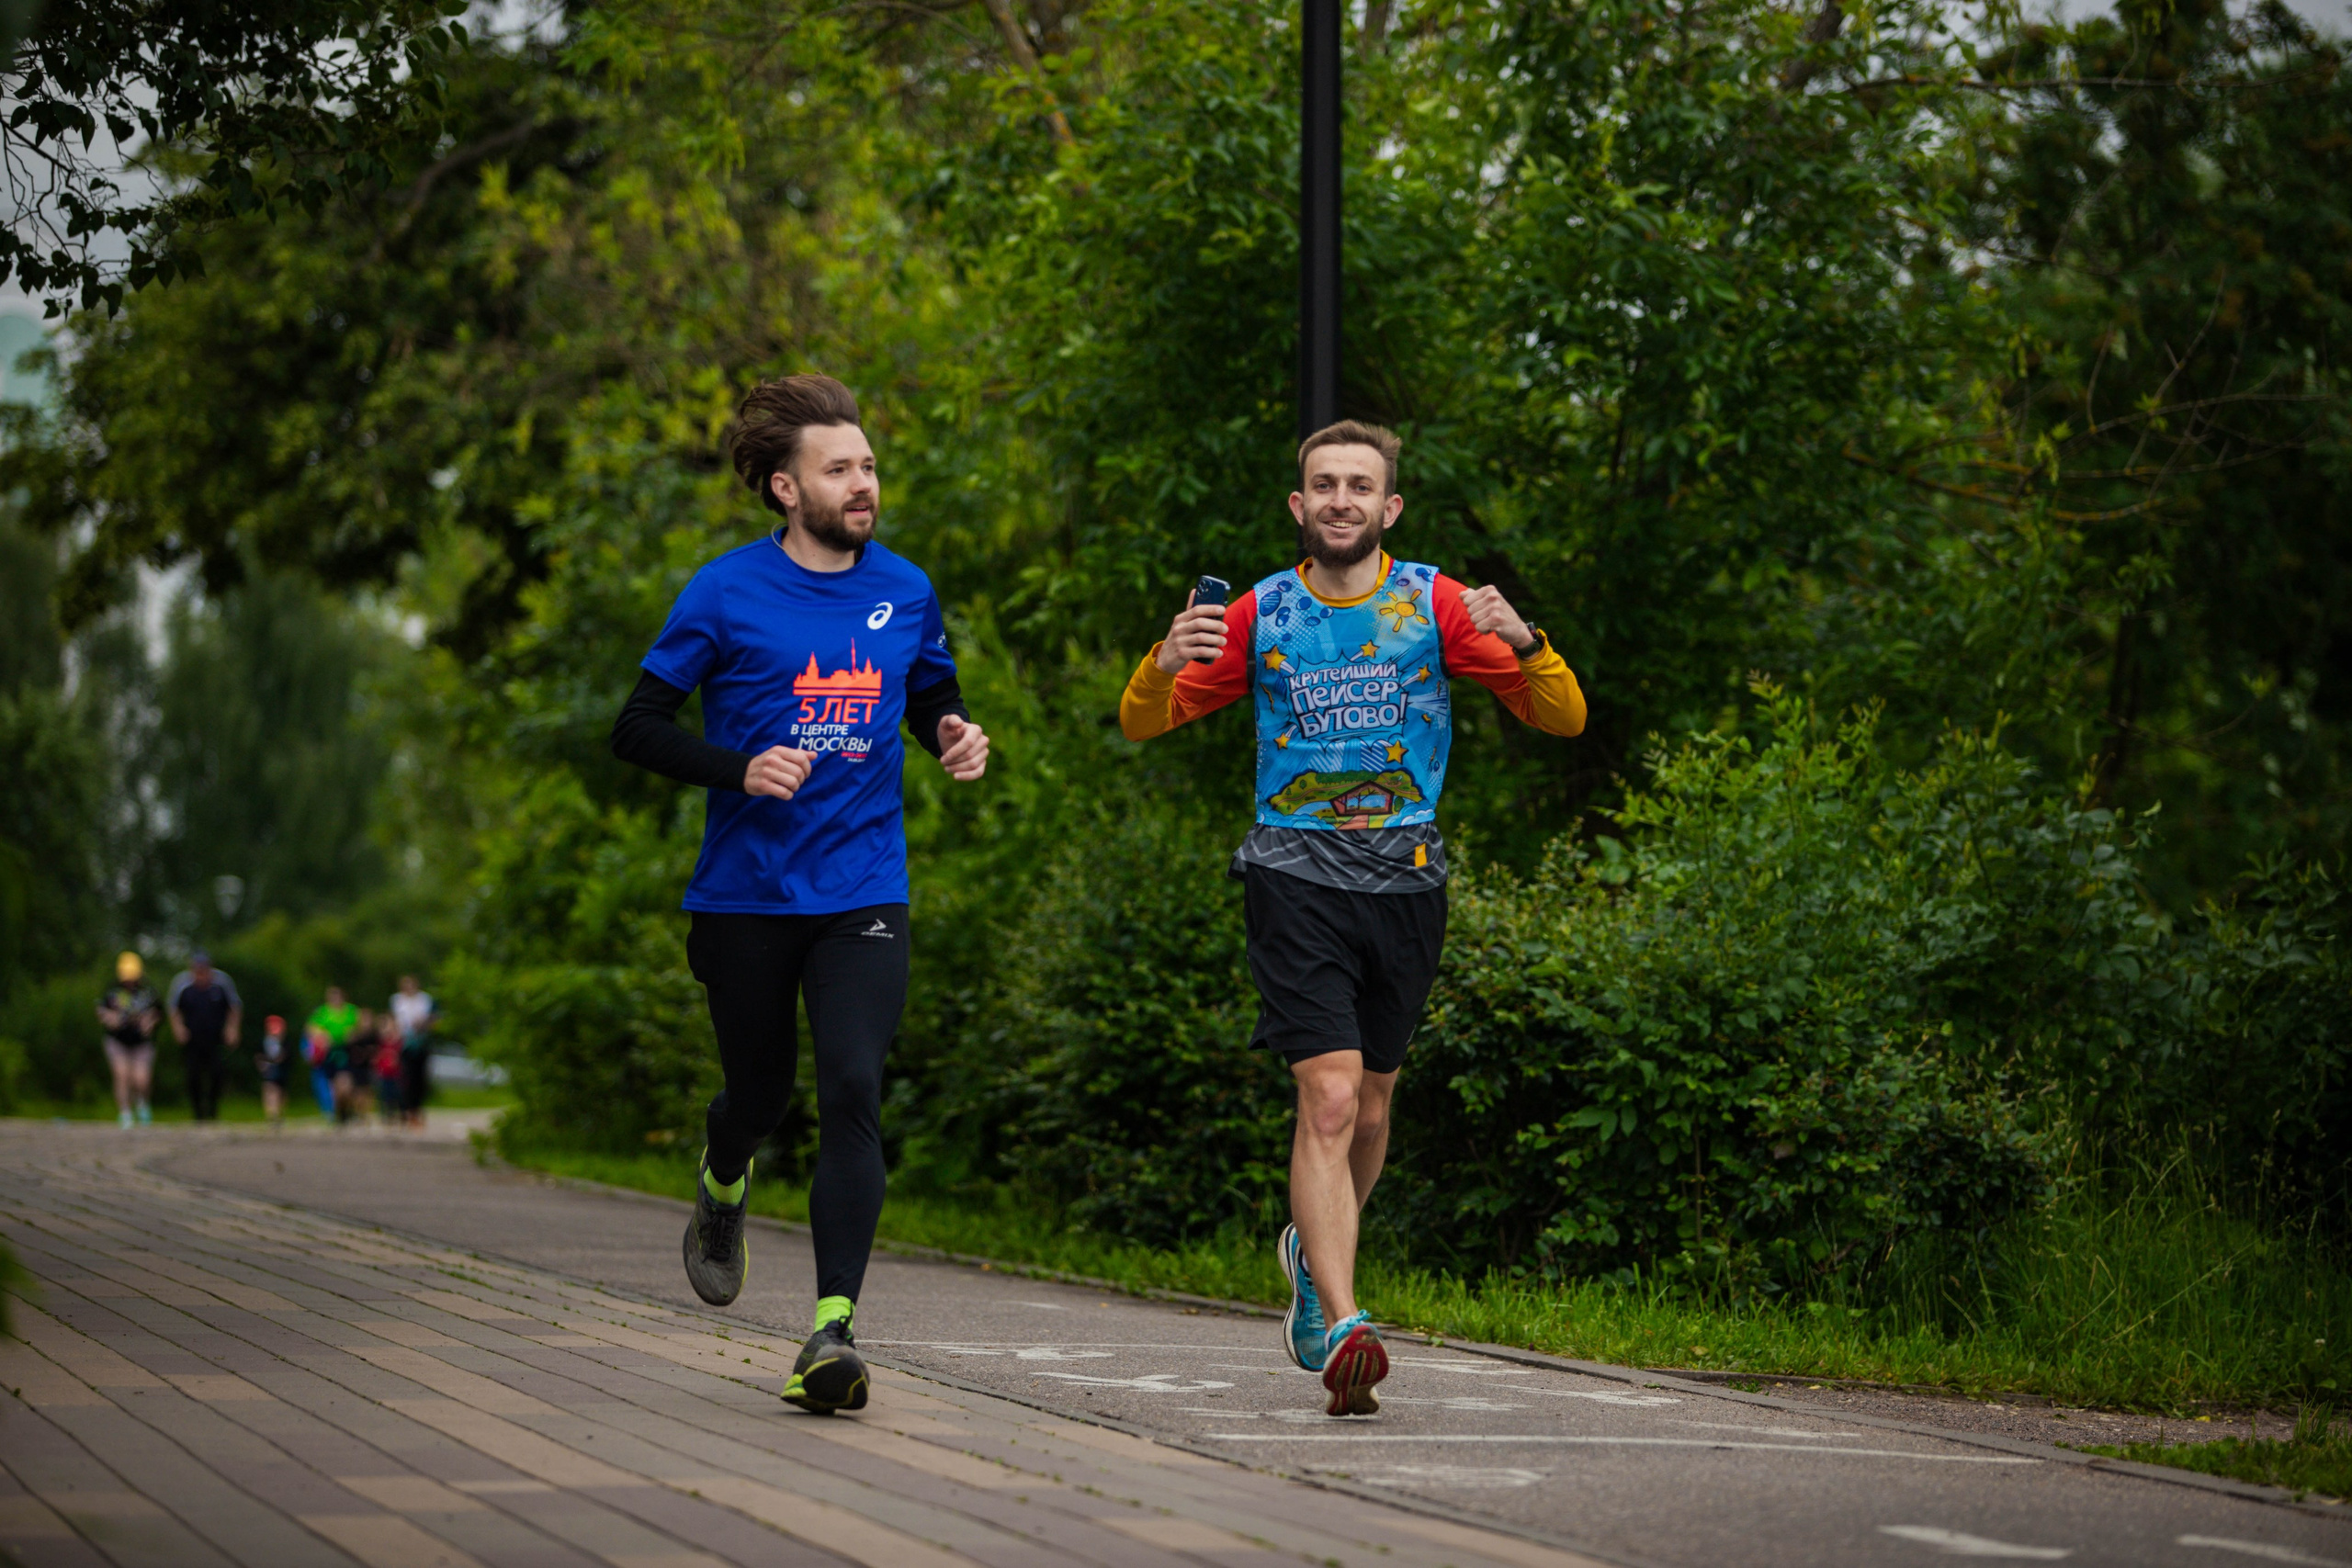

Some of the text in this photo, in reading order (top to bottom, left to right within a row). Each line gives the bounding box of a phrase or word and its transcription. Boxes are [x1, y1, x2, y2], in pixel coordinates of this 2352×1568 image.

[797, 697, 880, 724] 5 ЛЕТ
[1299, 692, 1408, 738] БУТОВО!
[790, 724, 849, 737] В ЦЕНТРЕ
[798, 737, 873, 751] МОСКВЫ
